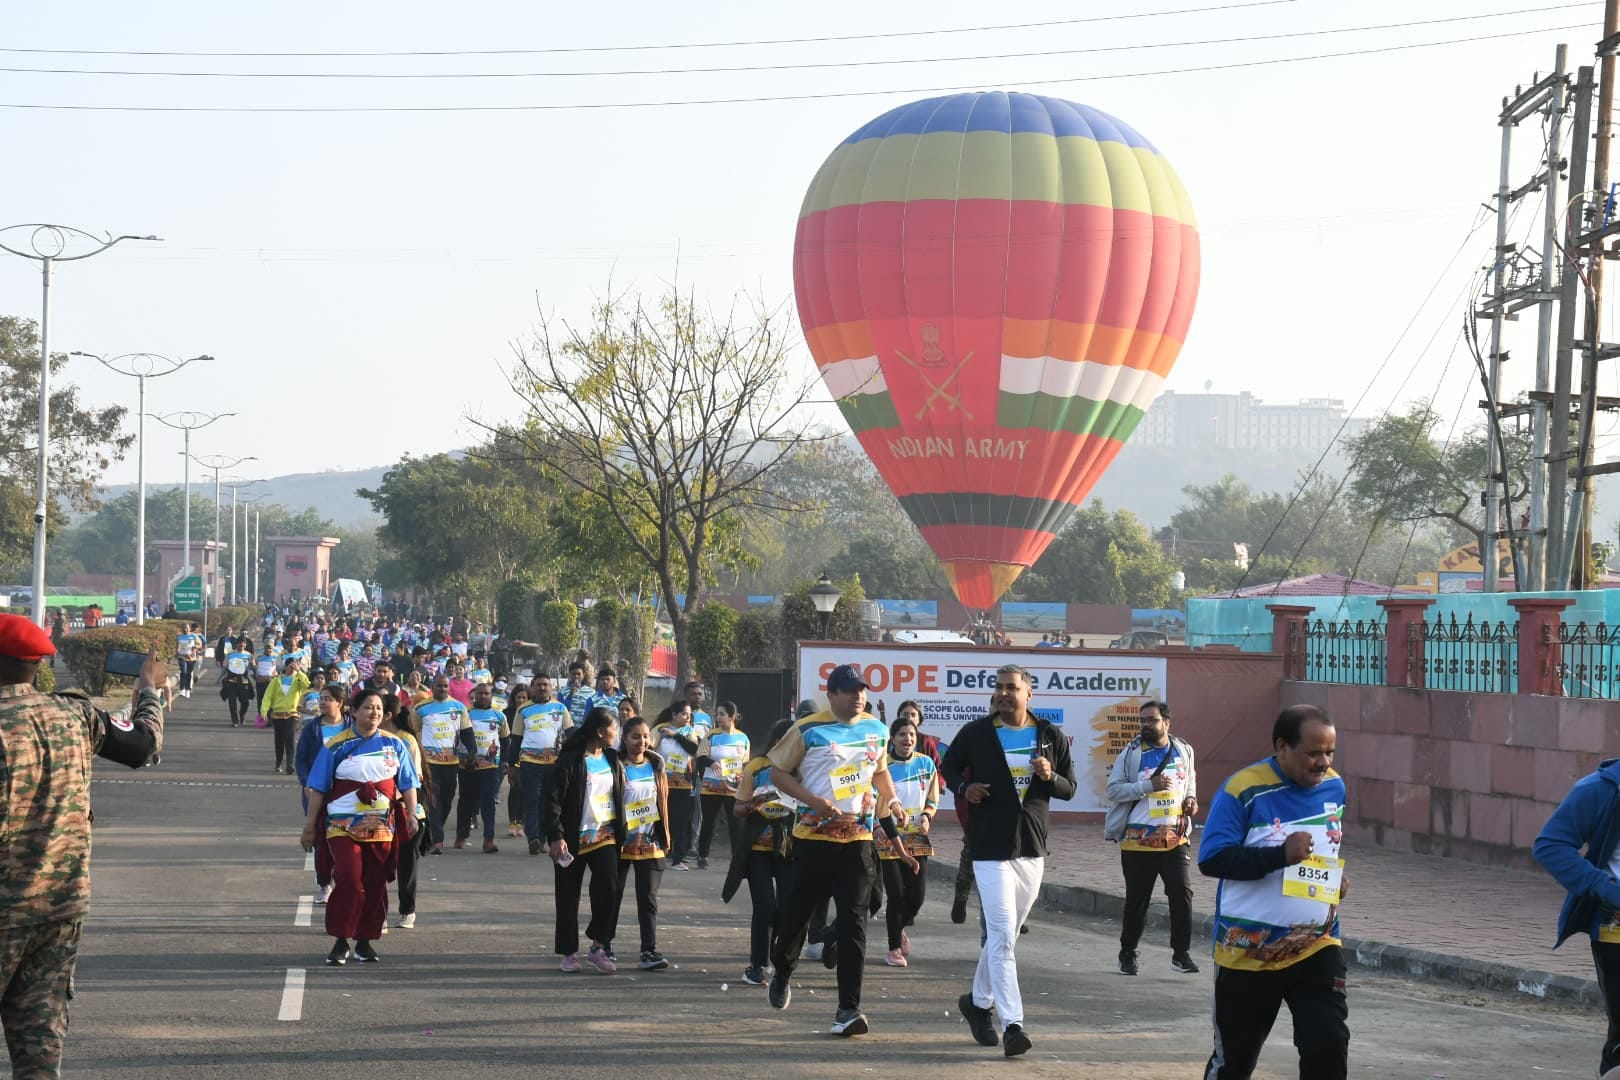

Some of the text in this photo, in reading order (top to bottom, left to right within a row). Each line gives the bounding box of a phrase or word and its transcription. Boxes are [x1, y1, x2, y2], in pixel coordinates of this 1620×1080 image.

[964, 437, 1031, 460] ARMY
[818, 662, 939, 693] SOPE
[946, 669, 1039, 689] Defee
[1047, 671, 1151, 695] Academy
[923, 705, 988, 713] SCOPE GLOBAL
[923, 713, 951, 721] SKILLS
[839, 772, 861, 785] 5901
[1012, 776, 1031, 785] 520
[631, 806, 650, 817] 7060
[1298, 866, 1329, 881] 8354
